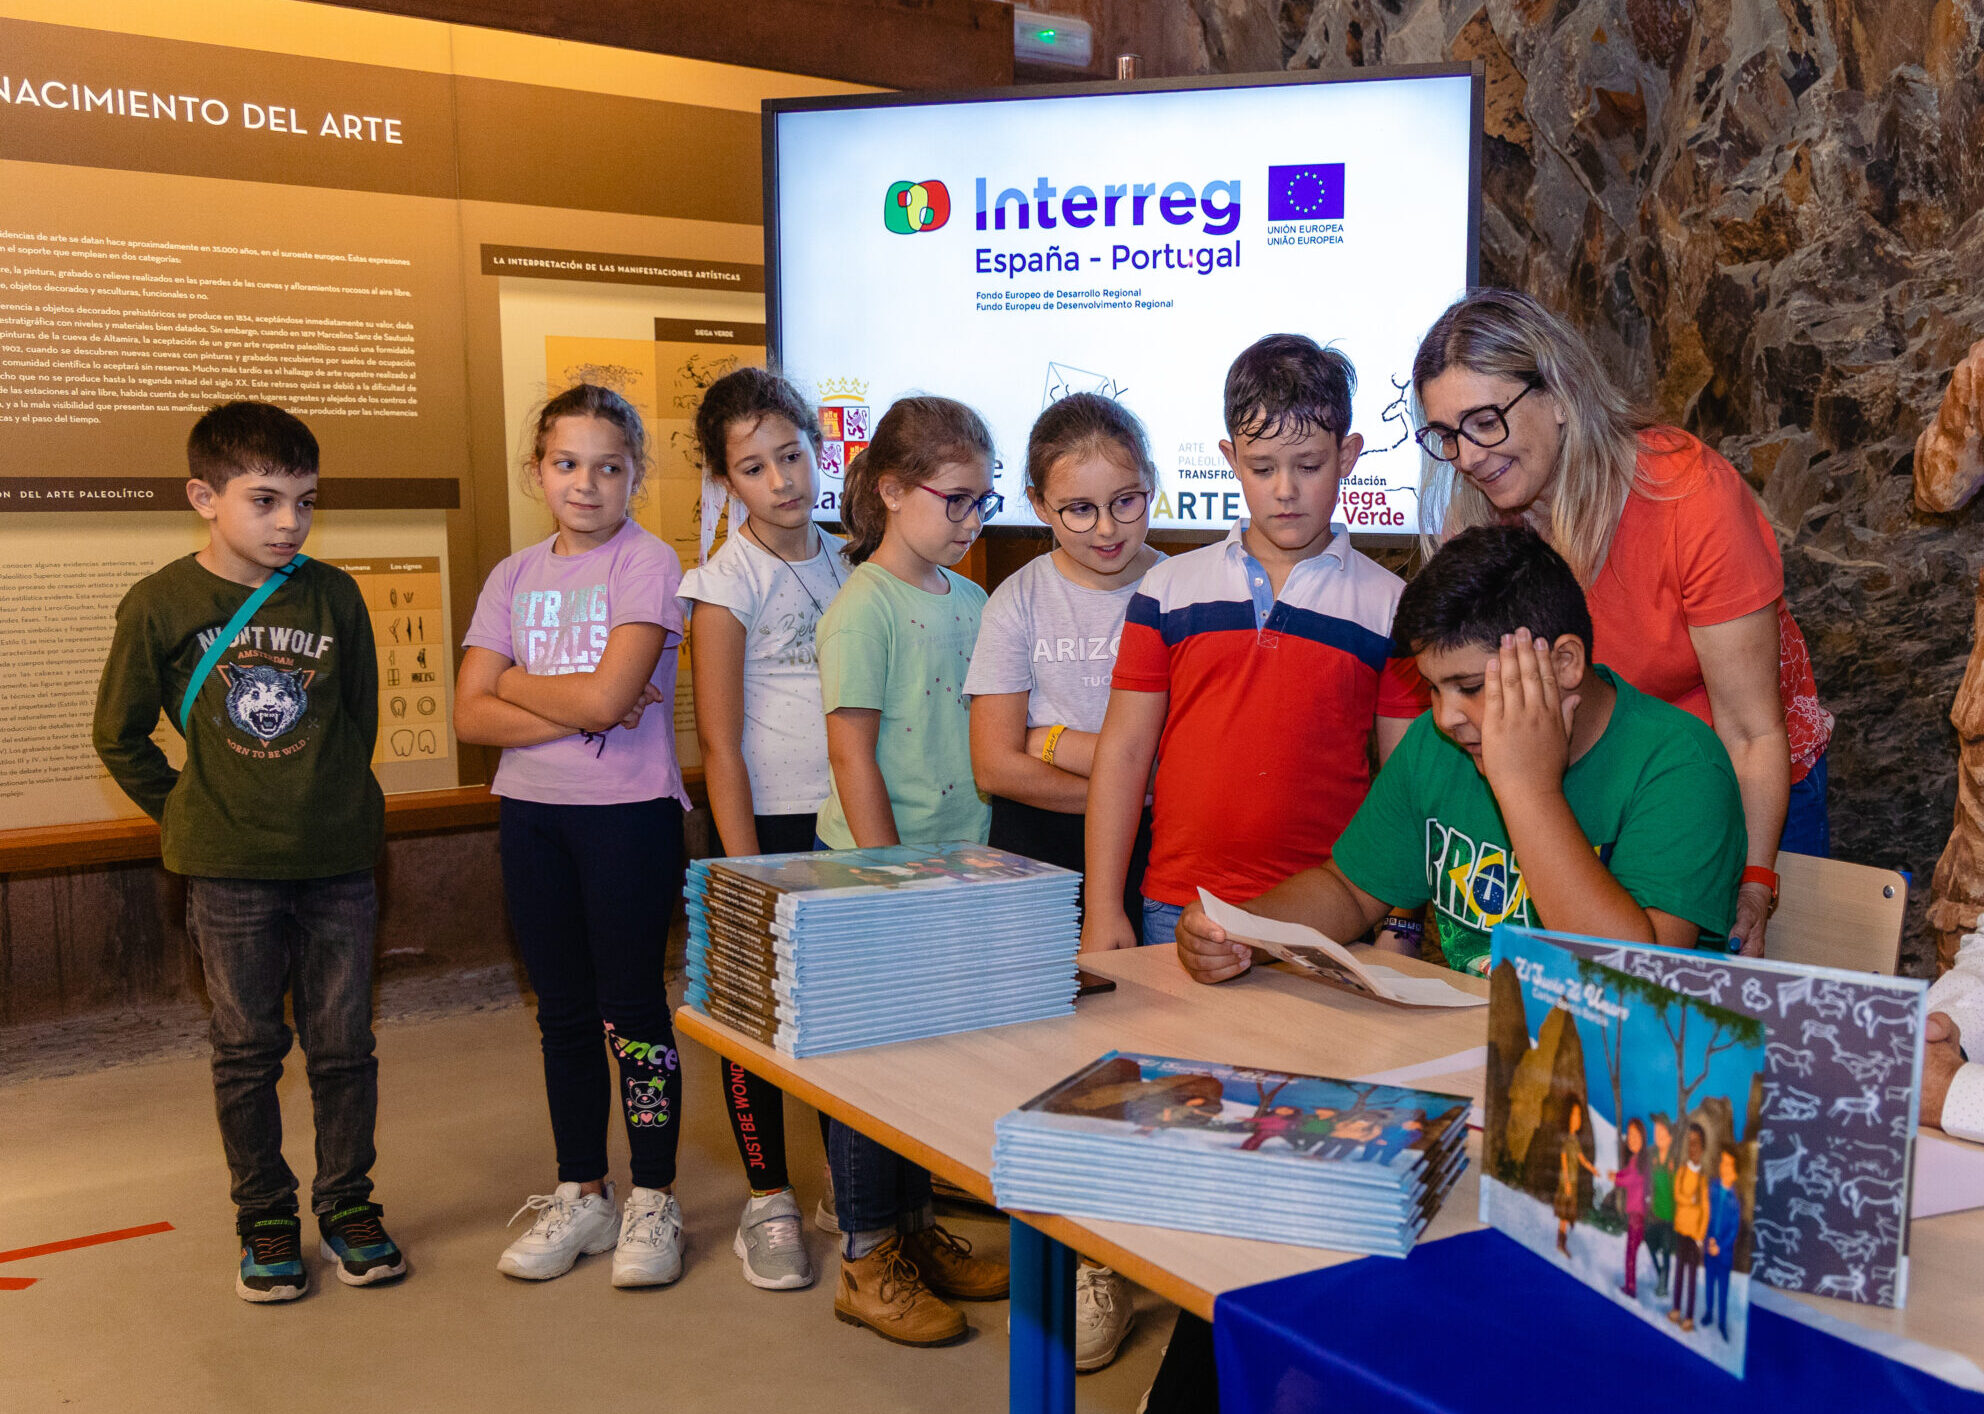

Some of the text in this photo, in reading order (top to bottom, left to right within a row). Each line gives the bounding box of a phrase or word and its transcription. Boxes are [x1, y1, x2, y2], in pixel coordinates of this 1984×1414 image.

[0, 76, 404, 145] NACIMIENTO DEL ARTE
[976, 177, 1241, 236] Interreg
[1267, 224, 1344, 235] UNIÓN EUROPEA
[50, 234, 67, 242] arte
[80, 234, 104, 244] datan
[106, 236, 126, 246] hace
[1267, 235, 1344, 246] UNIÃO EUROPEIA
[17, 247, 51, 257] soporte
[53, 249, 69, 258] que
[71, 249, 107, 260] emplean
[121, 251, 136, 261] dos
[976, 245, 1080, 279] España
[1112, 240, 1241, 276] Portugal
[493, 257, 741, 281] LA INTERPRETACIÓN DE LAS MANIFESTACIONES ARTÍSTICAS
[58, 269, 93, 280] grabado
[102, 271, 130, 281] relieve
[132, 273, 172, 284] realizados
[186, 276, 197, 285] las
[199, 277, 230, 288] paredes
[10, 281, 42, 293] objetos
[44, 282, 88, 293] decorados
[142, 287, 188, 299] funcionales
[976, 288, 1142, 301] Fondo Europeo de Desarrollo Regional
[0, 303, 32, 311] erencia
[42, 303, 74, 315] objetos
[76, 305, 120, 316] decorados
[188, 311, 221, 322] produce
[976, 299, 1174, 312] Fundo Europeu de Desenvolvimento Regional
[74, 319, 102, 329] niveles
[112, 321, 153, 331] materiales
[155, 322, 173, 332] bien
[0, 331, 35, 341] pinturas
[62, 334, 87, 342] cueva
[152, 337, 196, 348] aceptación
[26, 345, 58, 354] cuando
[73, 346, 118, 356] descubren
[200, 351, 232, 362] pinturas
[2, 358, 50, 368] comunidad
[52, 359, 90, 369] científica
[103, 361, 139, 372] aceptará
[141, 362, 152, 371] sin
[192, 363, 220, 373] Mucho
[18, 374, 35, 383] que
[65, 373, 100, 384] produce
[103, 374, 125, 383] hasta
[138, 375, 172, 387] segunda
[174, 376, 197, 386] mitad
[199, 377, 212, 386] del
[10, 385, 22, 394] las
[24, 386, 69, 395] estaciones
[80, 388, 96, 396] aire
[120, 388, 147, 398] habida
[149, 390, 176, 398] cuenta
[30, 400, 50, 409] mala
[52, 400, 94, 410] visibilidad
[96, 404, 112, 413] que
[114, 403, 154, 413] presentan
[32, 416, 52, 425] paso
[54, 413, 67, 423] del
[20, 490, 41, 499] DEL
[46, 490, 75, 498] ARTE
[79, 488, 154, 498] PALEOLÍTICO
[1338, 487, 1387, 510] iega
[1153, 491, 1241, 520] ARTE
[1343, 506, 1405, 526] Verde
[268, 626, 334, 660] WOLF
[252, 750, 265, 758] TO
[268, 750, 281, 759] BE
[282, 739, 306, 756] WILD
[737, 1112, 756, 1132] BE
[743, 1133, 766, 1170] JUST
